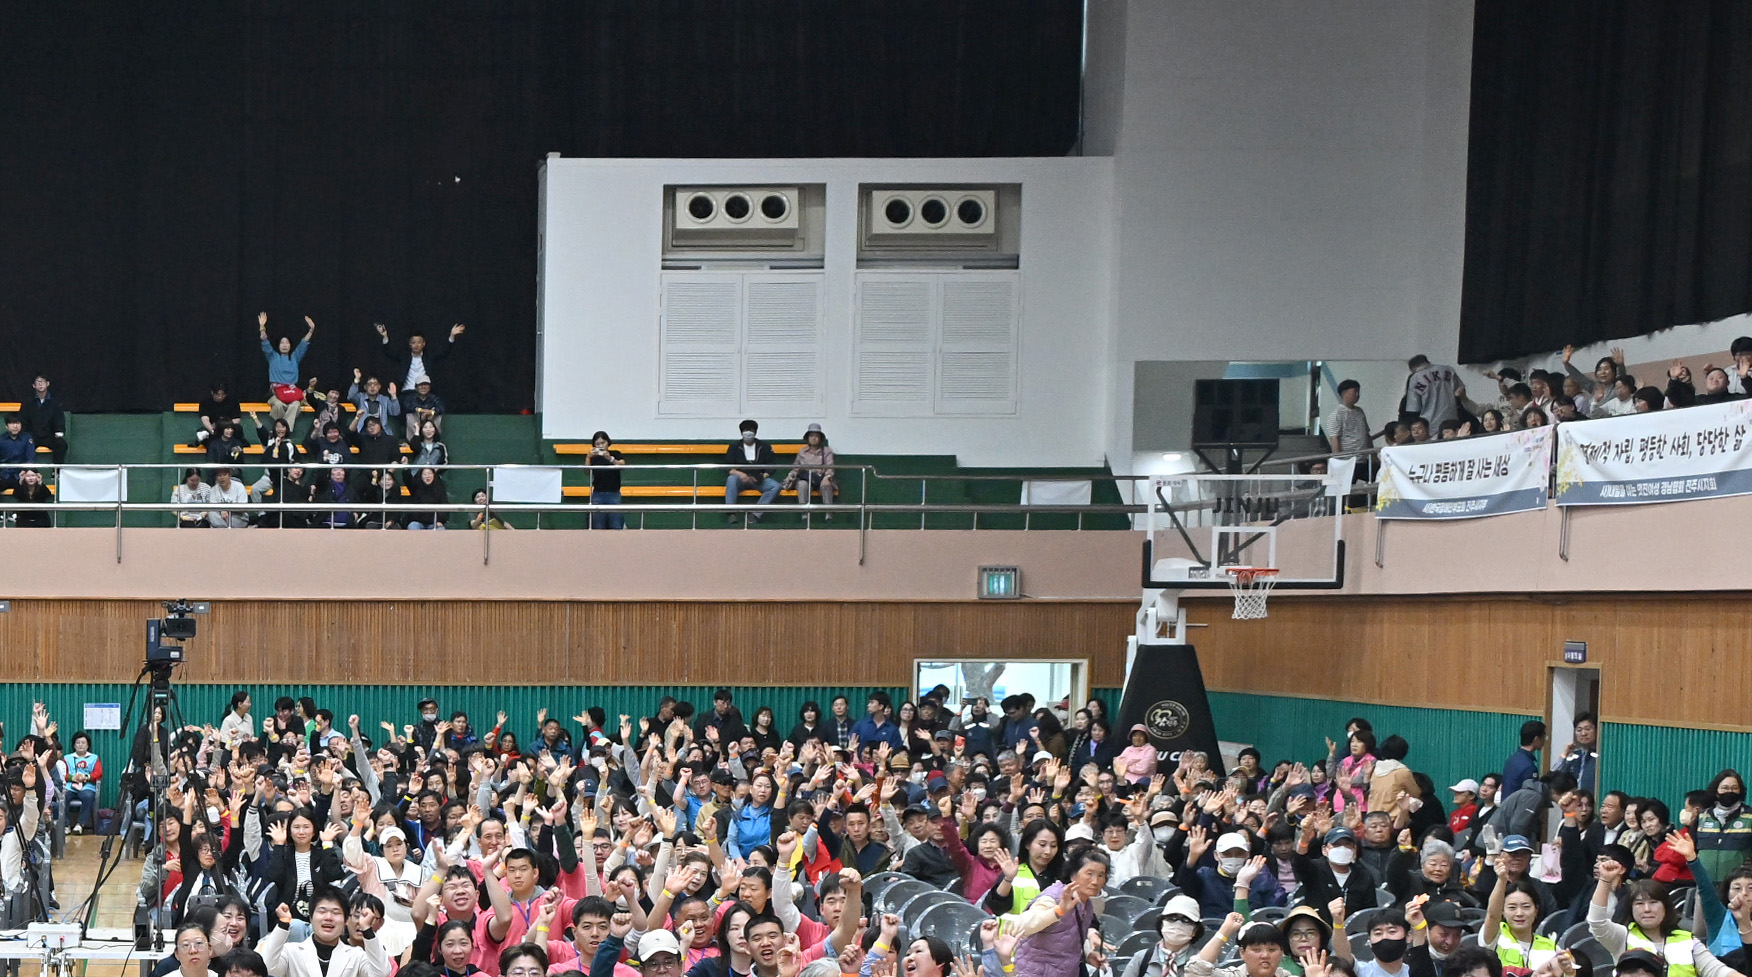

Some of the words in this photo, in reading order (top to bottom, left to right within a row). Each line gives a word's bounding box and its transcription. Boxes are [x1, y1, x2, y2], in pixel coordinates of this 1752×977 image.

[1414, 369, 1454, 394] NIKE
[1612, 437, 1634, 464] 자립,
[1638, 434, 1667, 462] 평등한
[1669, 431, 1692, 459] 사회,
[1696, 426, 1730, 456] 당당한
[1733, 424, 1746, 452] 삶
[1408, 464, 1433, 484] 누구나
[1433, 460, 1466, 483] 평등하게
[1466, 459, 1475, 480] 잘
[1476, 458, 1492, 479] 사는
[1492, 454, 1511, 477] 세상
[1212, 497, 1280, 514] JINJU
